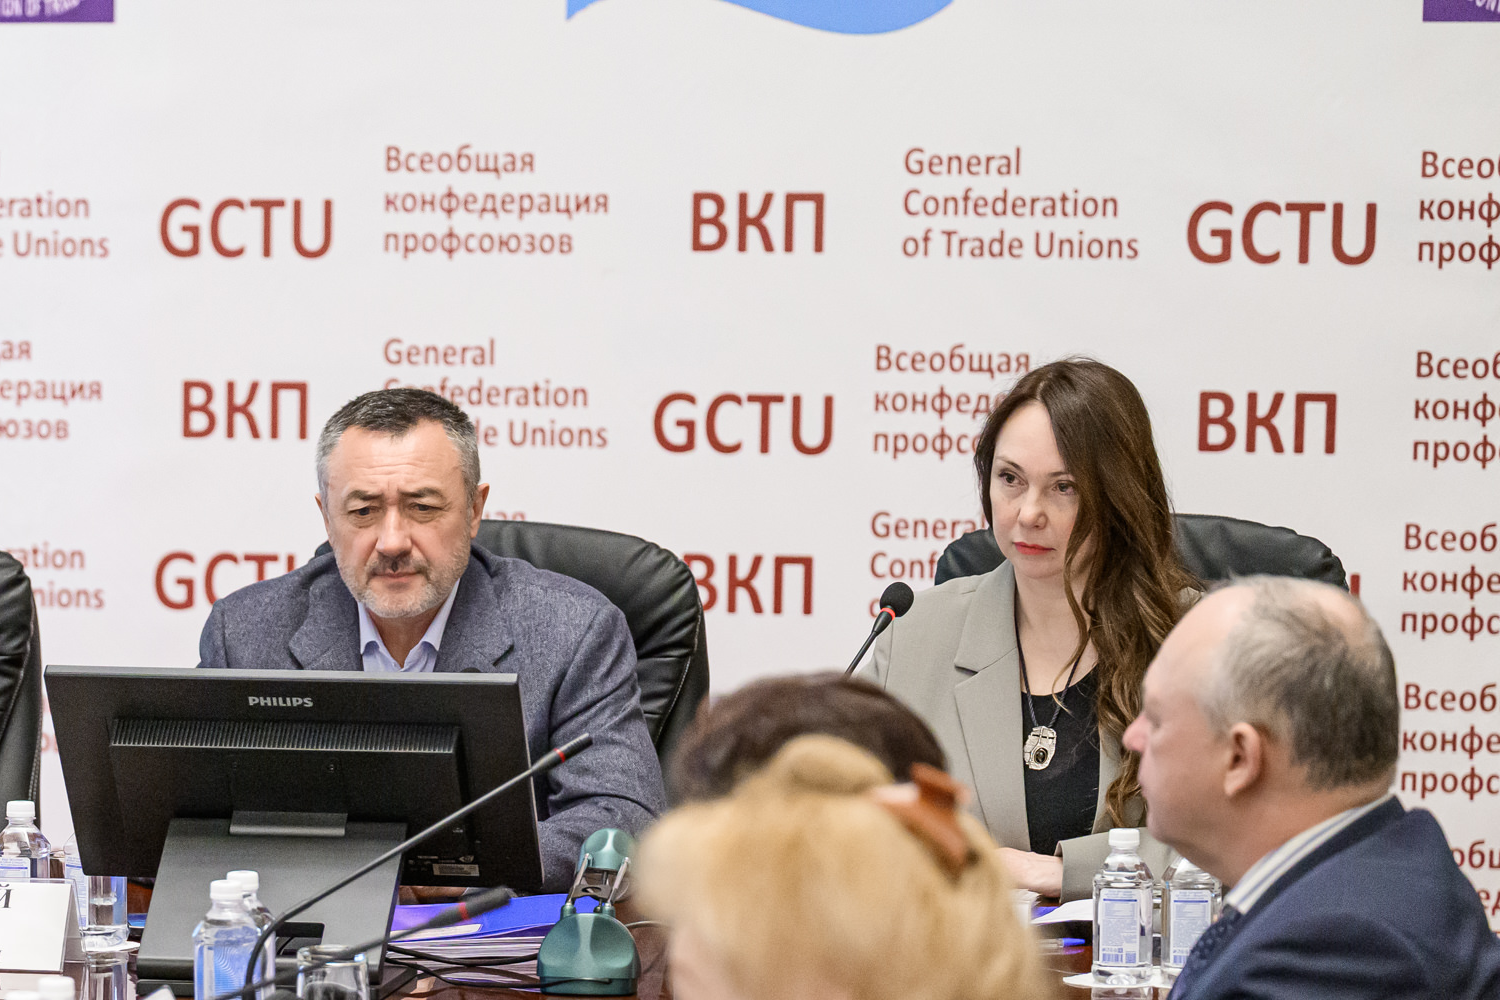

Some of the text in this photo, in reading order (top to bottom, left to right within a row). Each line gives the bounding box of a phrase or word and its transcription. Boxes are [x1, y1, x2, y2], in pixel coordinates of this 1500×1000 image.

[386, 144, 535, 180] Всеобщая
[904, 147, 1021, 176] General
[1421, 150, 1500, 180] Всео
[385, 186, 608, 221] конфедерация
[903, 187, 1118, 218] Confederation
[159, 197, 334, 260] GCTU
[691, 191, 825, 254] ВКП
[1186, 200, 1377, 266] GCTU
[13, 232, 109, 258] Unions
[384, 226, 573, 260] профсоюзов
[902, 227, 1139, 261] of Trade Unions
[384, 338, 496, 366] General
[876, 343, 1030, 379] Всеобщая
[182, 379, 309, 441] ВКП
[383, 377, 589, 409] federation
[508, 420, 608, 449] Unions
[652, 391, 834, 456] GCTU
[1197, 390, 1337, 455] ВКП
[870, 510, 988, 541] General
[32, 581, 105, 610] nions
[154, 550, 295, 611] GCT
[682, 552, 814, 616] ВКП
[248, 696, 314, 708] PHILIPS
